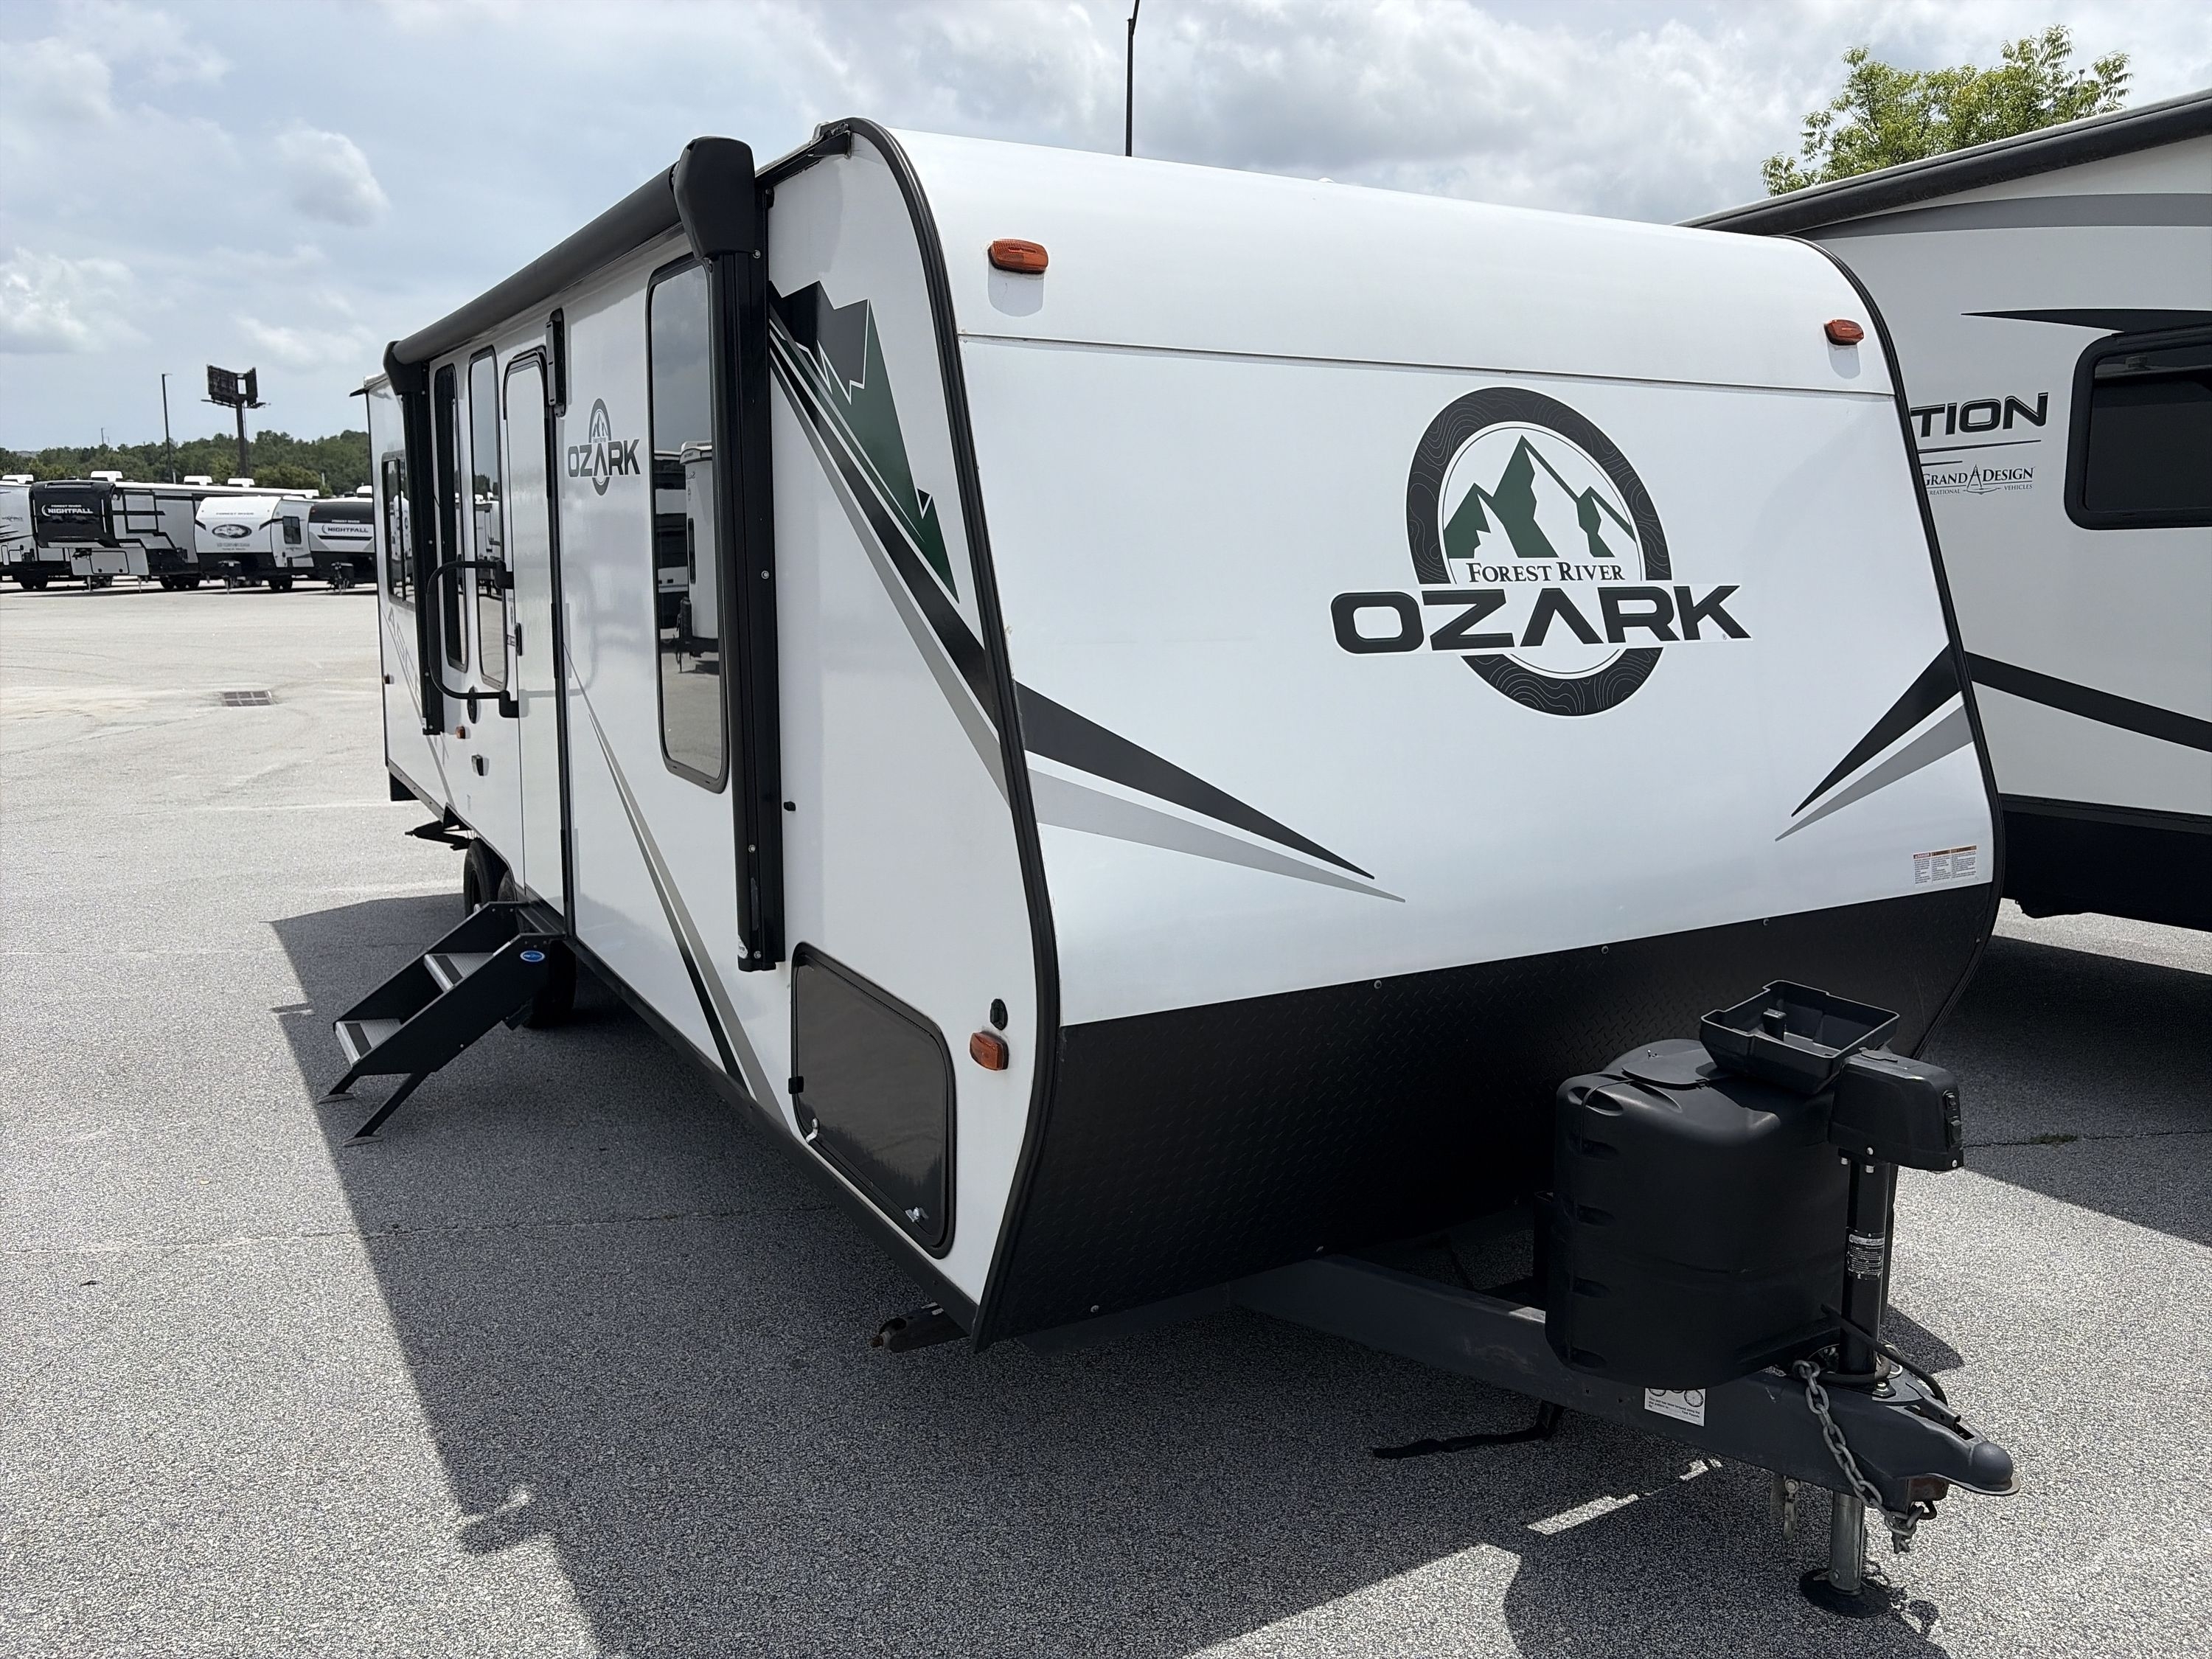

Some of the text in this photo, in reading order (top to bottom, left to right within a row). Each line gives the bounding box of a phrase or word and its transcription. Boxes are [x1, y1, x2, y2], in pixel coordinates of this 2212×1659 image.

[568, 439, 641, 478] OZARK
[1922, 467, 2034, 486] GRAND DESIGN
[1466, 561, 1625, 583] FOREST RIVER
[1331, 585, 1751, 655] OZARK
